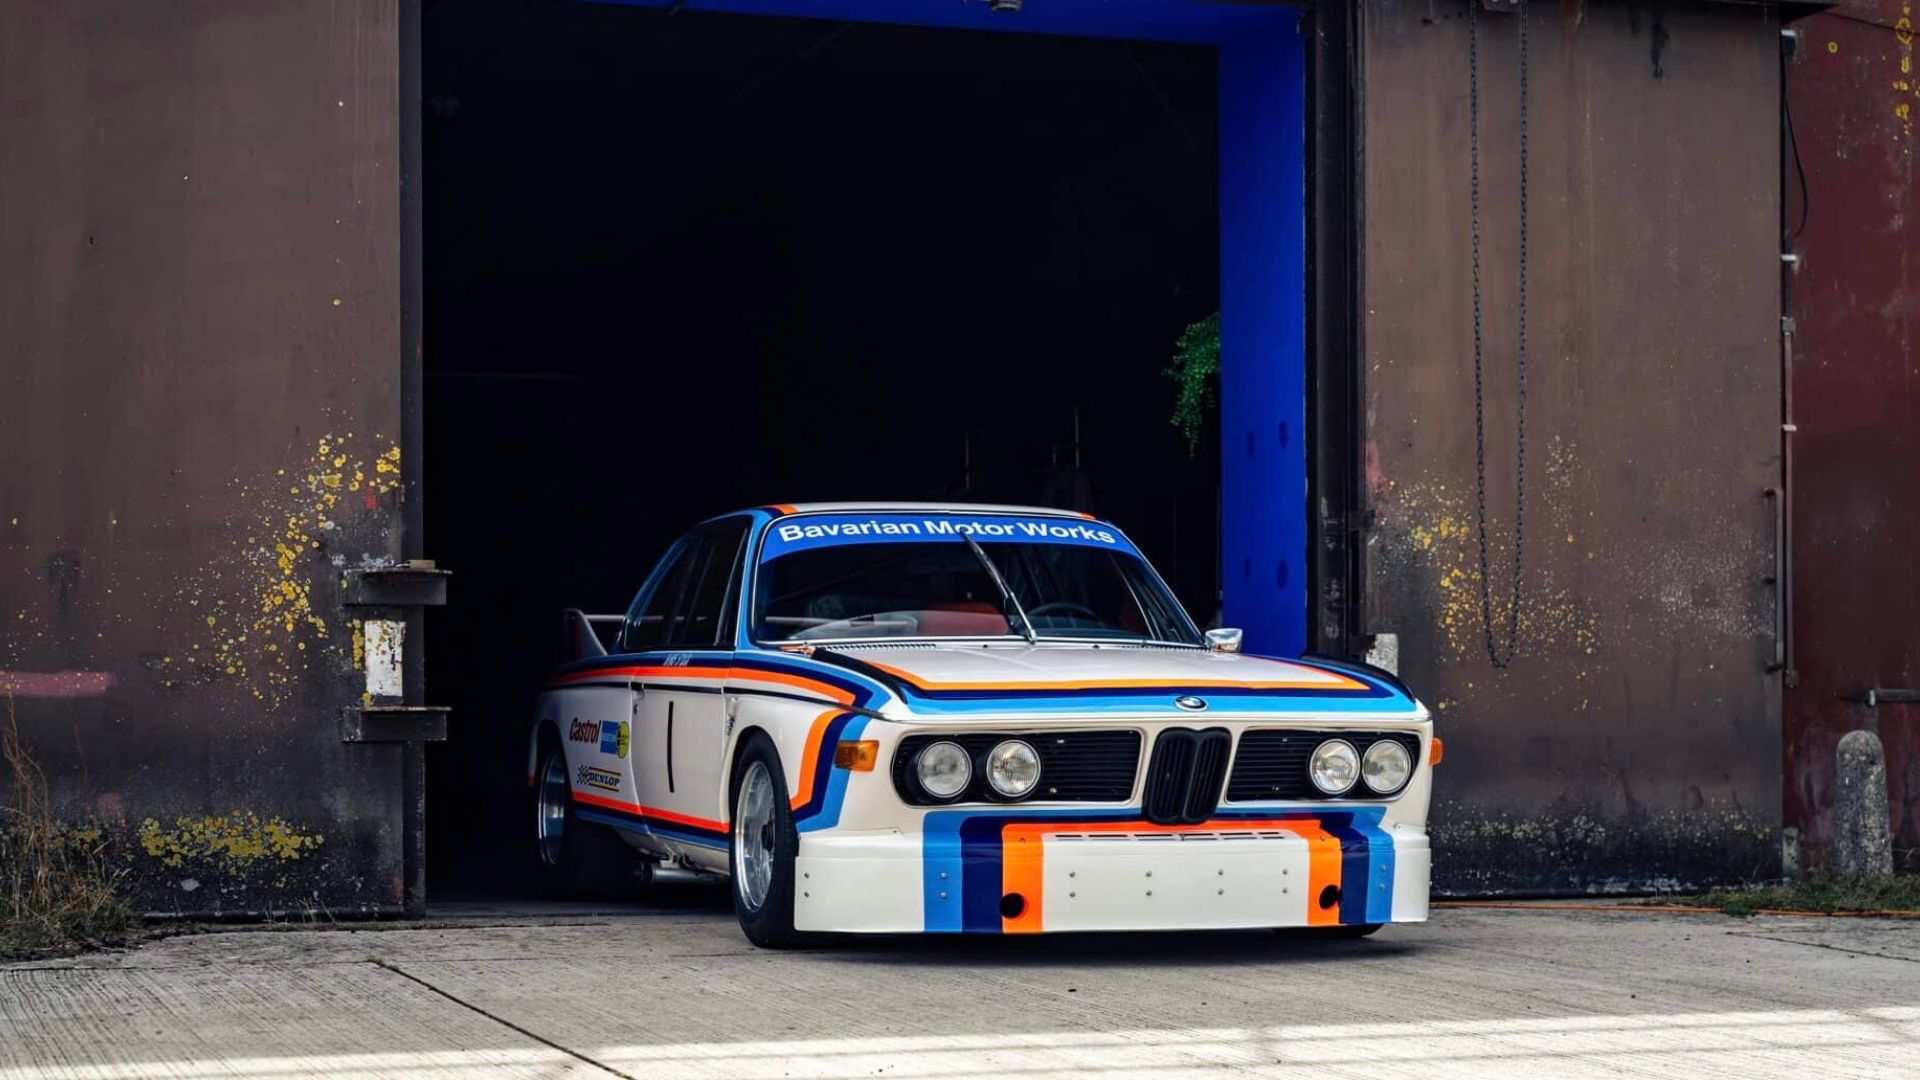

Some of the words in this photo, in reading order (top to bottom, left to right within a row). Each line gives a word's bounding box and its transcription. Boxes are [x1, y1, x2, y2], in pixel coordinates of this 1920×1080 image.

[778, 520, 921, 543] Bavarian
[923, 520, 1015, 536] Motor
[1017, 522, 1116, 544] Works
[569, 717, 602, 745] Castrol
[589, 772, 621, 787] DUNLOP
